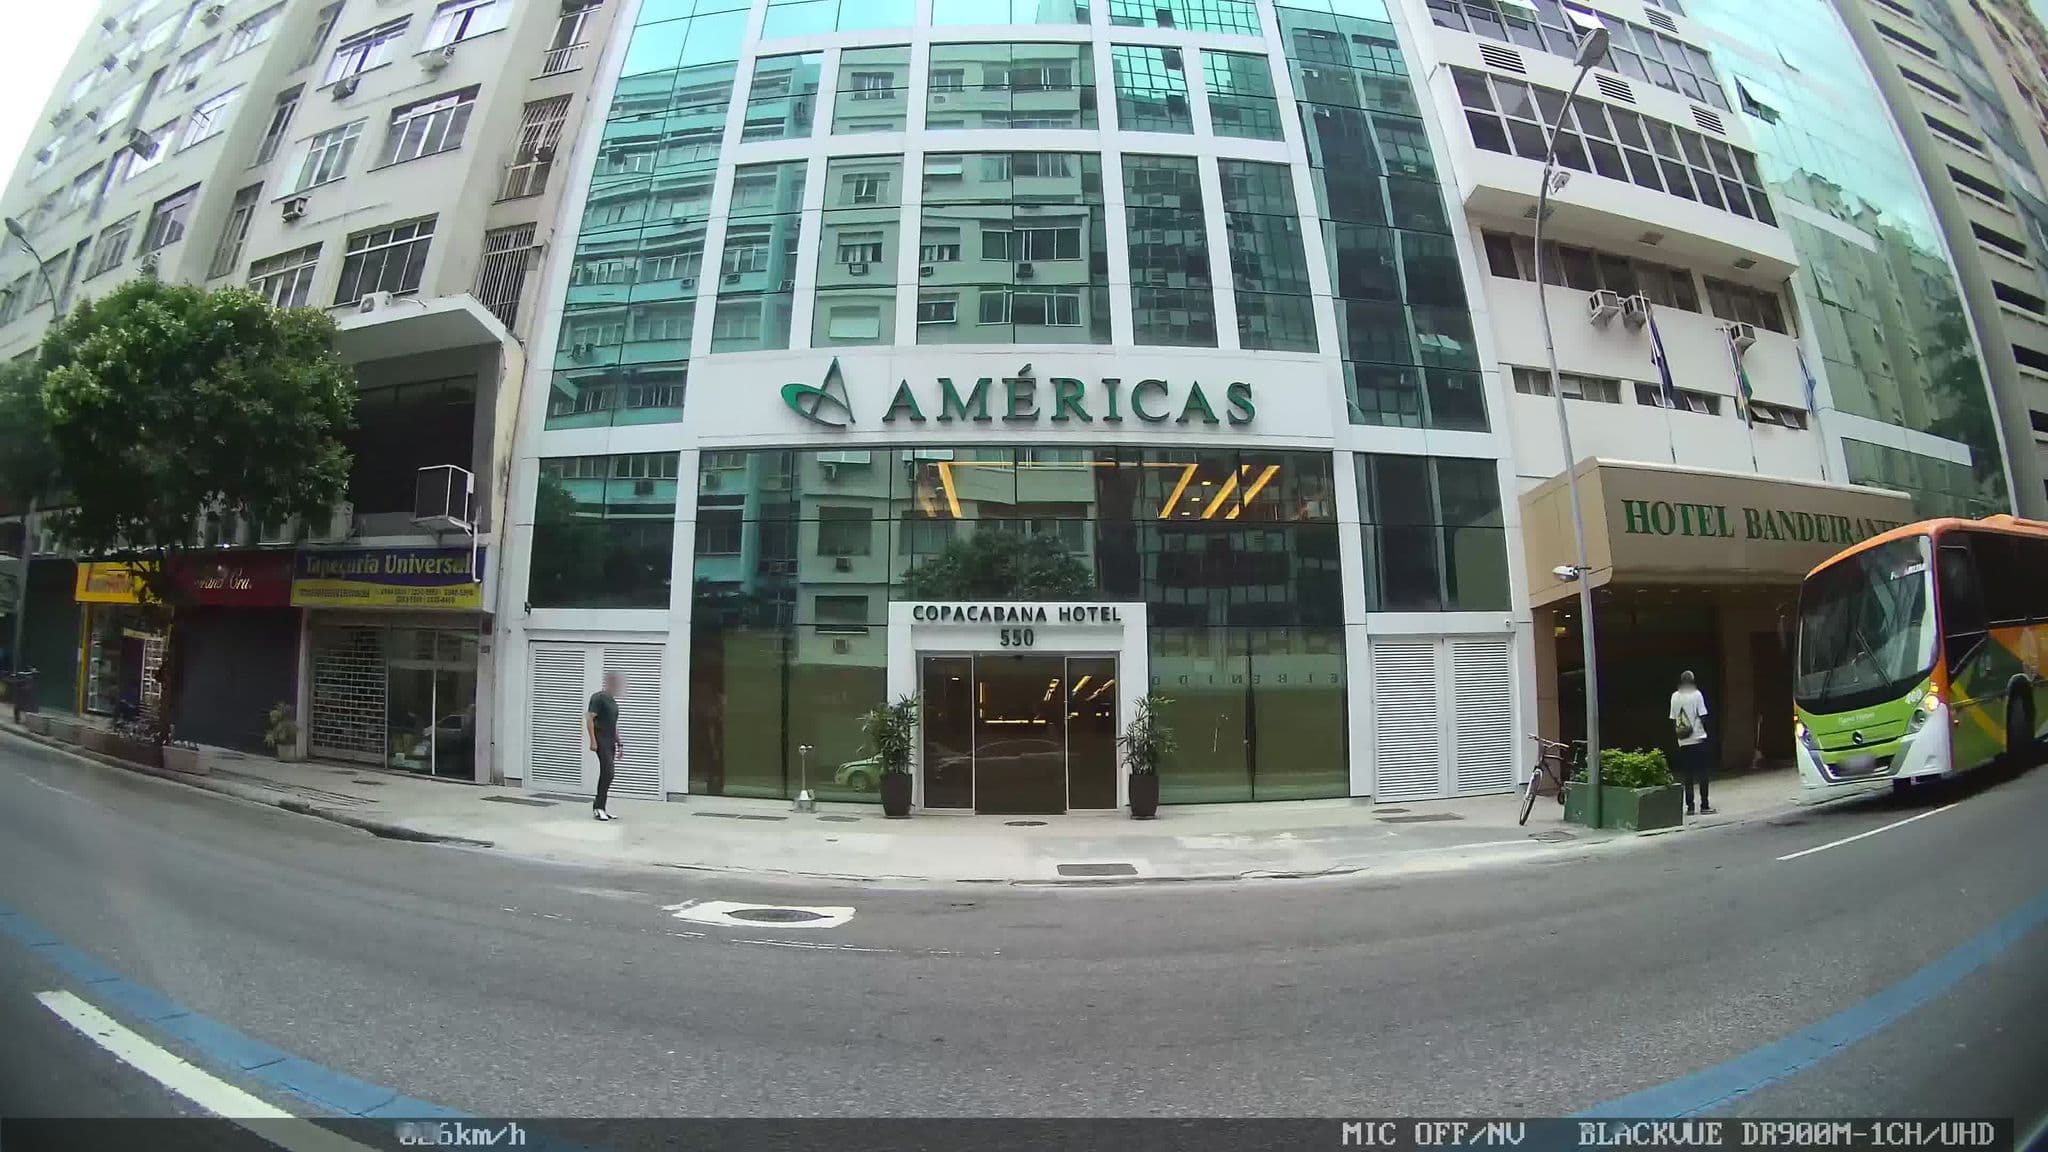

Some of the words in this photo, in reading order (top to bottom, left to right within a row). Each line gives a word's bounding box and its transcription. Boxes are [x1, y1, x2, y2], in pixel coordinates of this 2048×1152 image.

[882, 363, 1256, 425] AMÉRICAS
[1621, 498, 1735, 538] HOTEL
[1742, 507, 1909, 546] BANDEIRAN
[912, 605, 1047, 622] COPACABANA
[1059, 606, 1122, 622] HOTEL
[1000, 628, 1034, 646] 550
